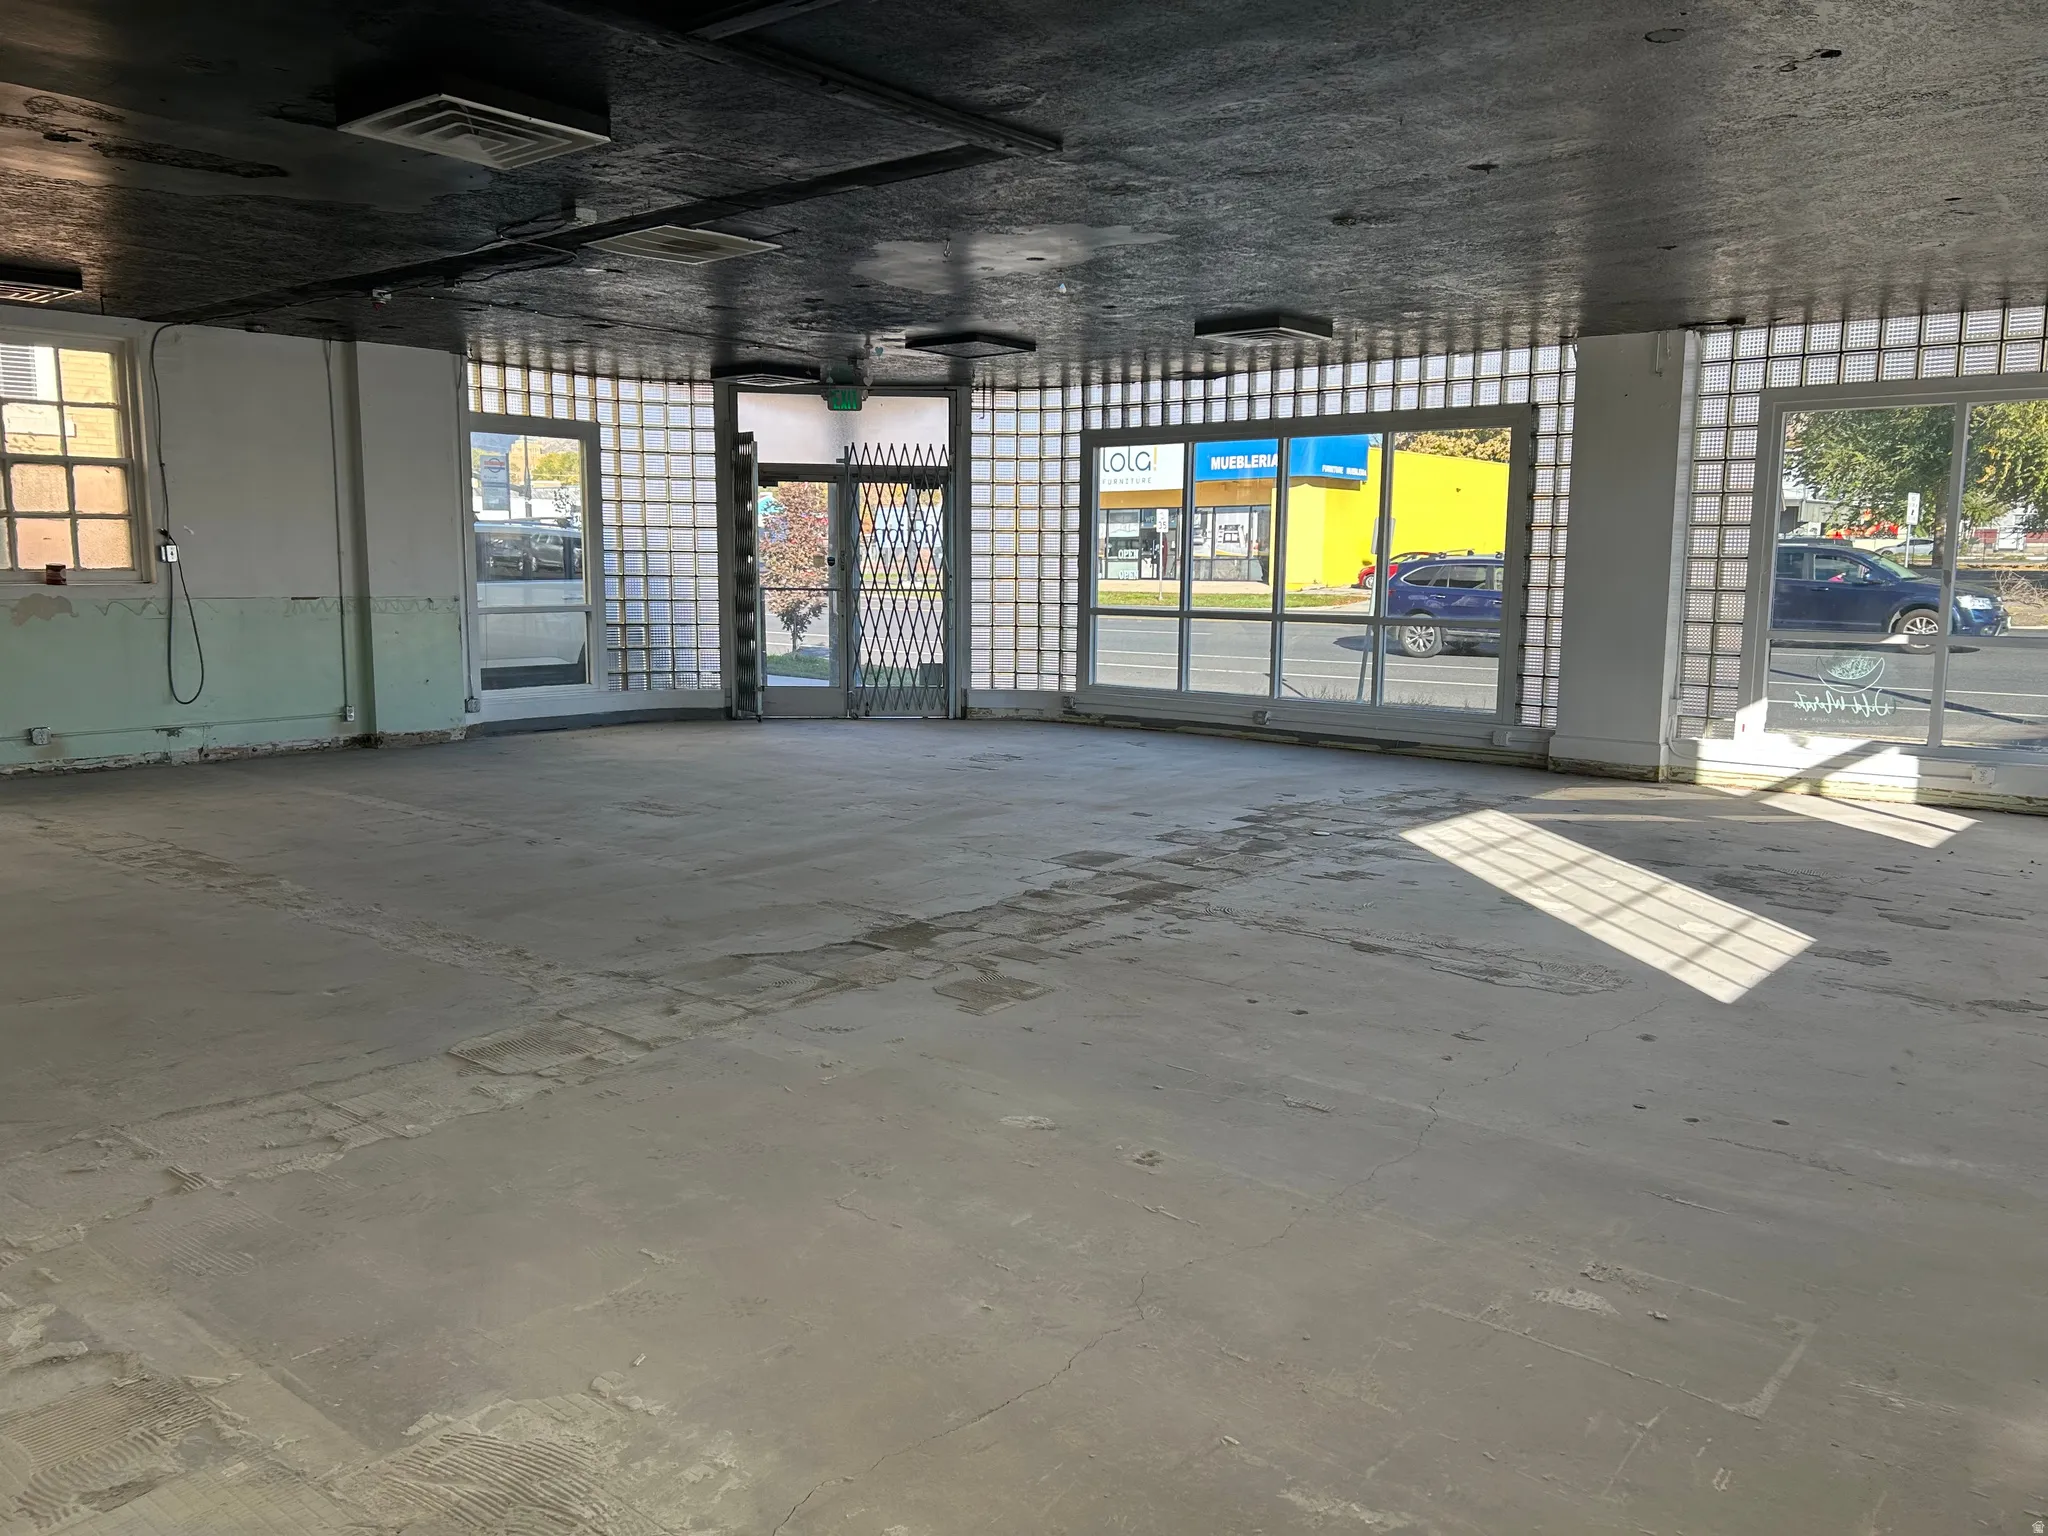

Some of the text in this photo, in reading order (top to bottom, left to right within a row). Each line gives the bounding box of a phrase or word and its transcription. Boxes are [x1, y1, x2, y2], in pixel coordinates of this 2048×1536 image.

[832, 389, 857, 410] EXIT
[1102, 446, 1158, 473] lola!
[1210, 454, 1278, 470] MUEBLERIA
[1102, 477, 1152, 485] FURNITURE
[1118, 549, 1139, 560] OPEN
